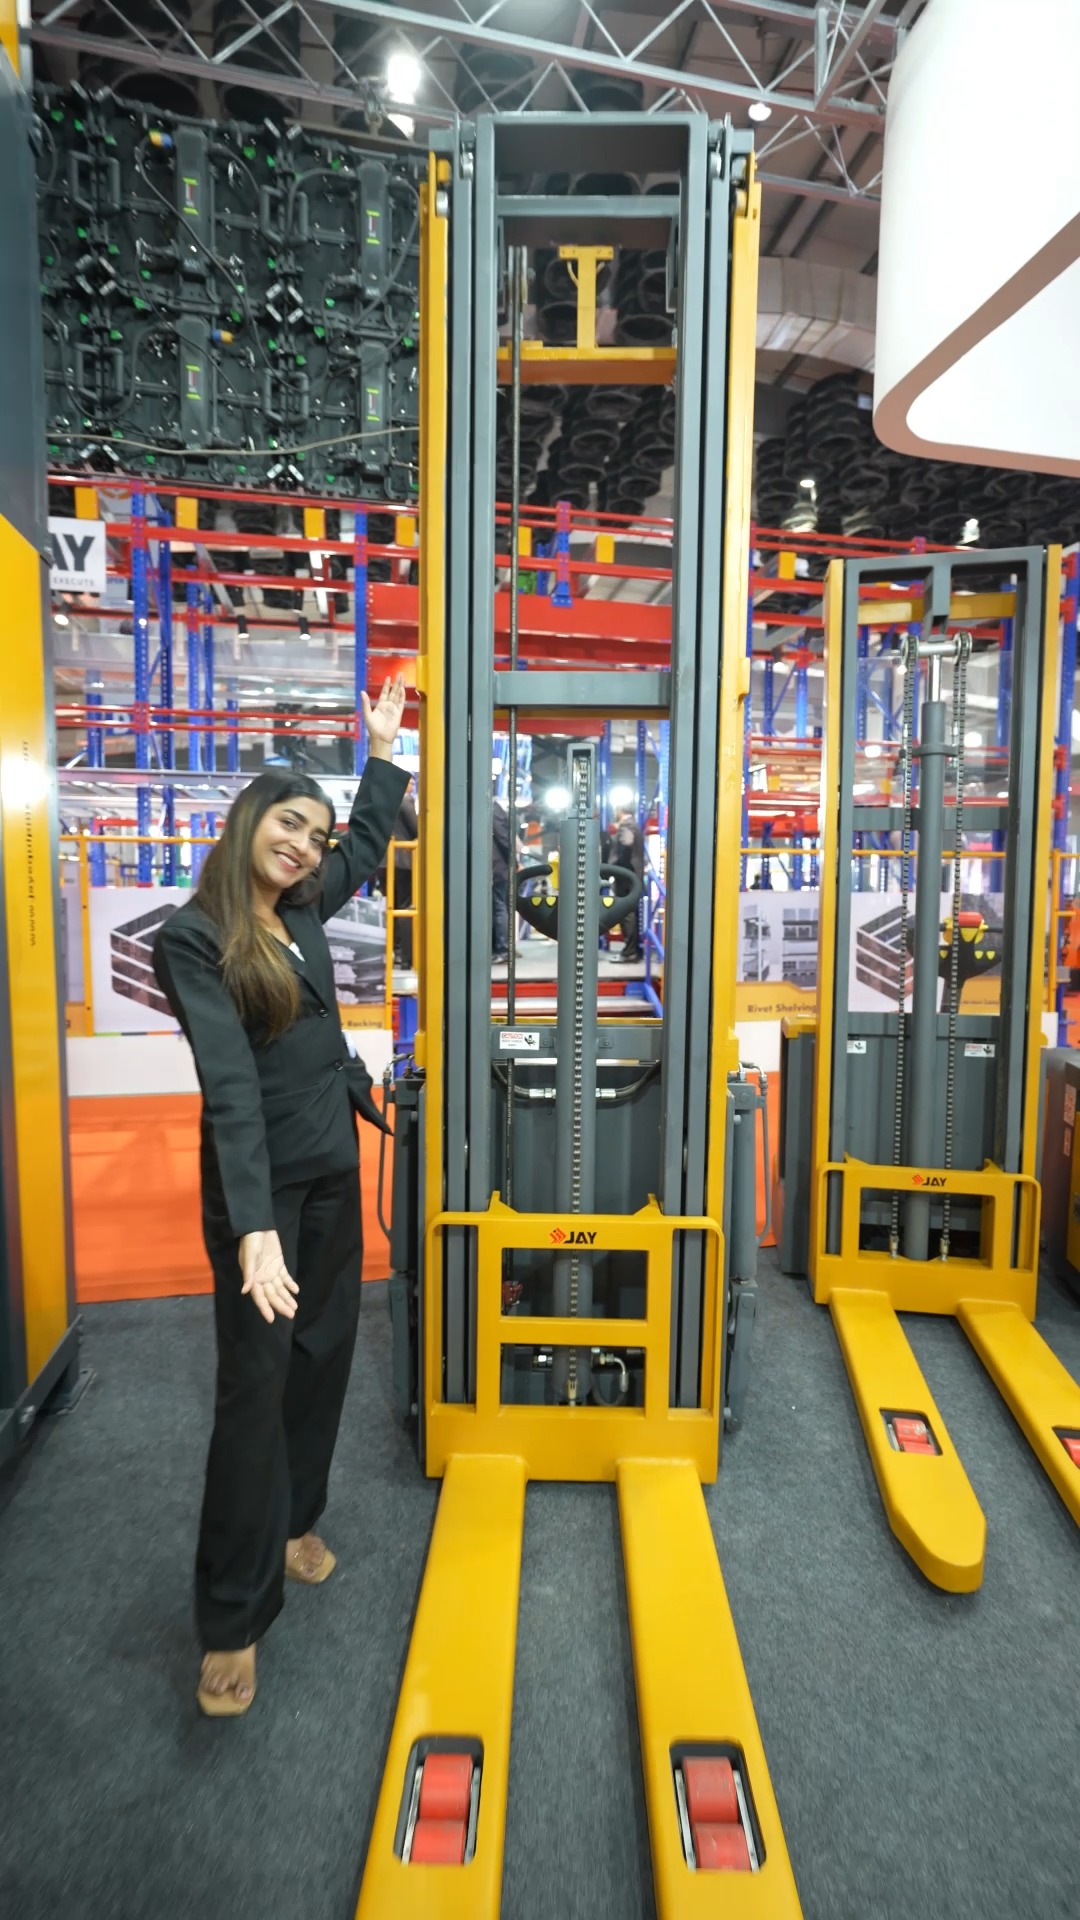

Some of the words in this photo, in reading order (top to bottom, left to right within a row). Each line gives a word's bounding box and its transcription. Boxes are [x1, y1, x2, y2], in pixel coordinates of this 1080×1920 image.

[50, 533, 95, 572] AY
[747, 1004, 772, 1013] Rivet
[922, 1177, 947, 1187] JAY
[564, 1231, 597, 1244] JAY
